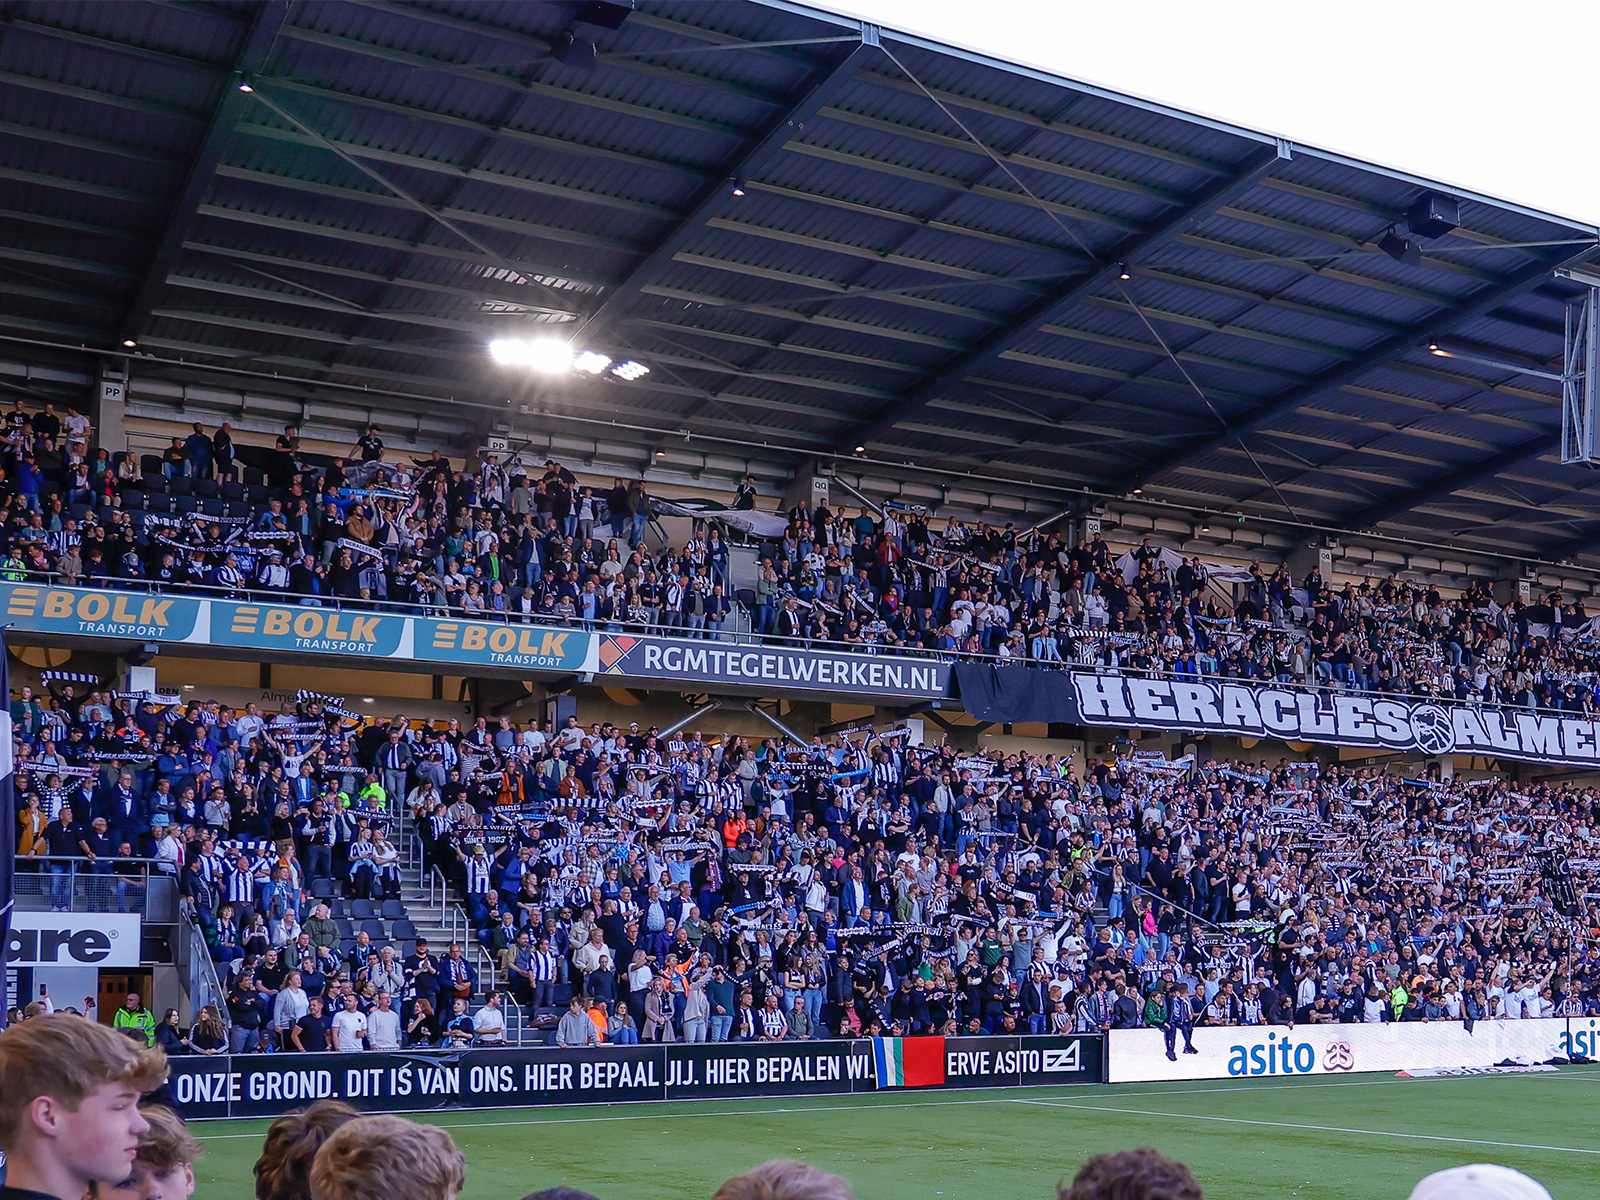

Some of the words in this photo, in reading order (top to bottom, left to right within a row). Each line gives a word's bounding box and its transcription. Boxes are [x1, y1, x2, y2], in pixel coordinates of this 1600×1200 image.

[105, 386, 120, 398] PP
[814, 481, 828, 490] QQ
[1088, 523, 1099, 532] QQ
[1321, 552, 1330, 560] QQ
[1520, 584, 1529, 592] QQ
[43, 591, 174, 626] BOLK
[79, 622, 165, 637] TRANSPORT
[263, 609, 382, 643] BOLK
[295, 638, 374, 653] TRANSPORT
[461, 625, 570, 657] BOLK
[490, 653, 562, 667] TRANSPORT
[644, 644, 943, 692] RGMTEGELWERKEN.NL
[261, 690, 295, 702] Alme
[325, 706, 360, 720] HERACLES
[1075, 674, 1412, 742] HERACLES
[1452, 708, 1600, 758] ALME
[463, 836, 486, 844] SINCE
[488, 835, 506, 843] 1903
[1559, 1020, 1600, 1057] asi
[1228, 1032, 1315, 1076] asito
[947, 1051, 990, 1076] ERVE
[994, 1049, 1039, 1074] ASITO
[177, 1073, 241, 1103] ONZE
[249, 1070, 338, 1100] GROND.
[347, 1068, 383, 1097] DIT
[390, 1067, 412, 1096] IS
[418, 1067, 460, 1094] VAN
[470, 1065, 518, 1093] ONS.
[525, 1063, 573, 1091] HIER
[580, 1061, 660, 1089] BEPAAL
[664, 1060, 699, 1086] JIJ.
[706, 1058, 750, 1085] HIER
[756, 1056, 840, 1083] BEPALEN
[846, 1054, 875, 1079] WI
